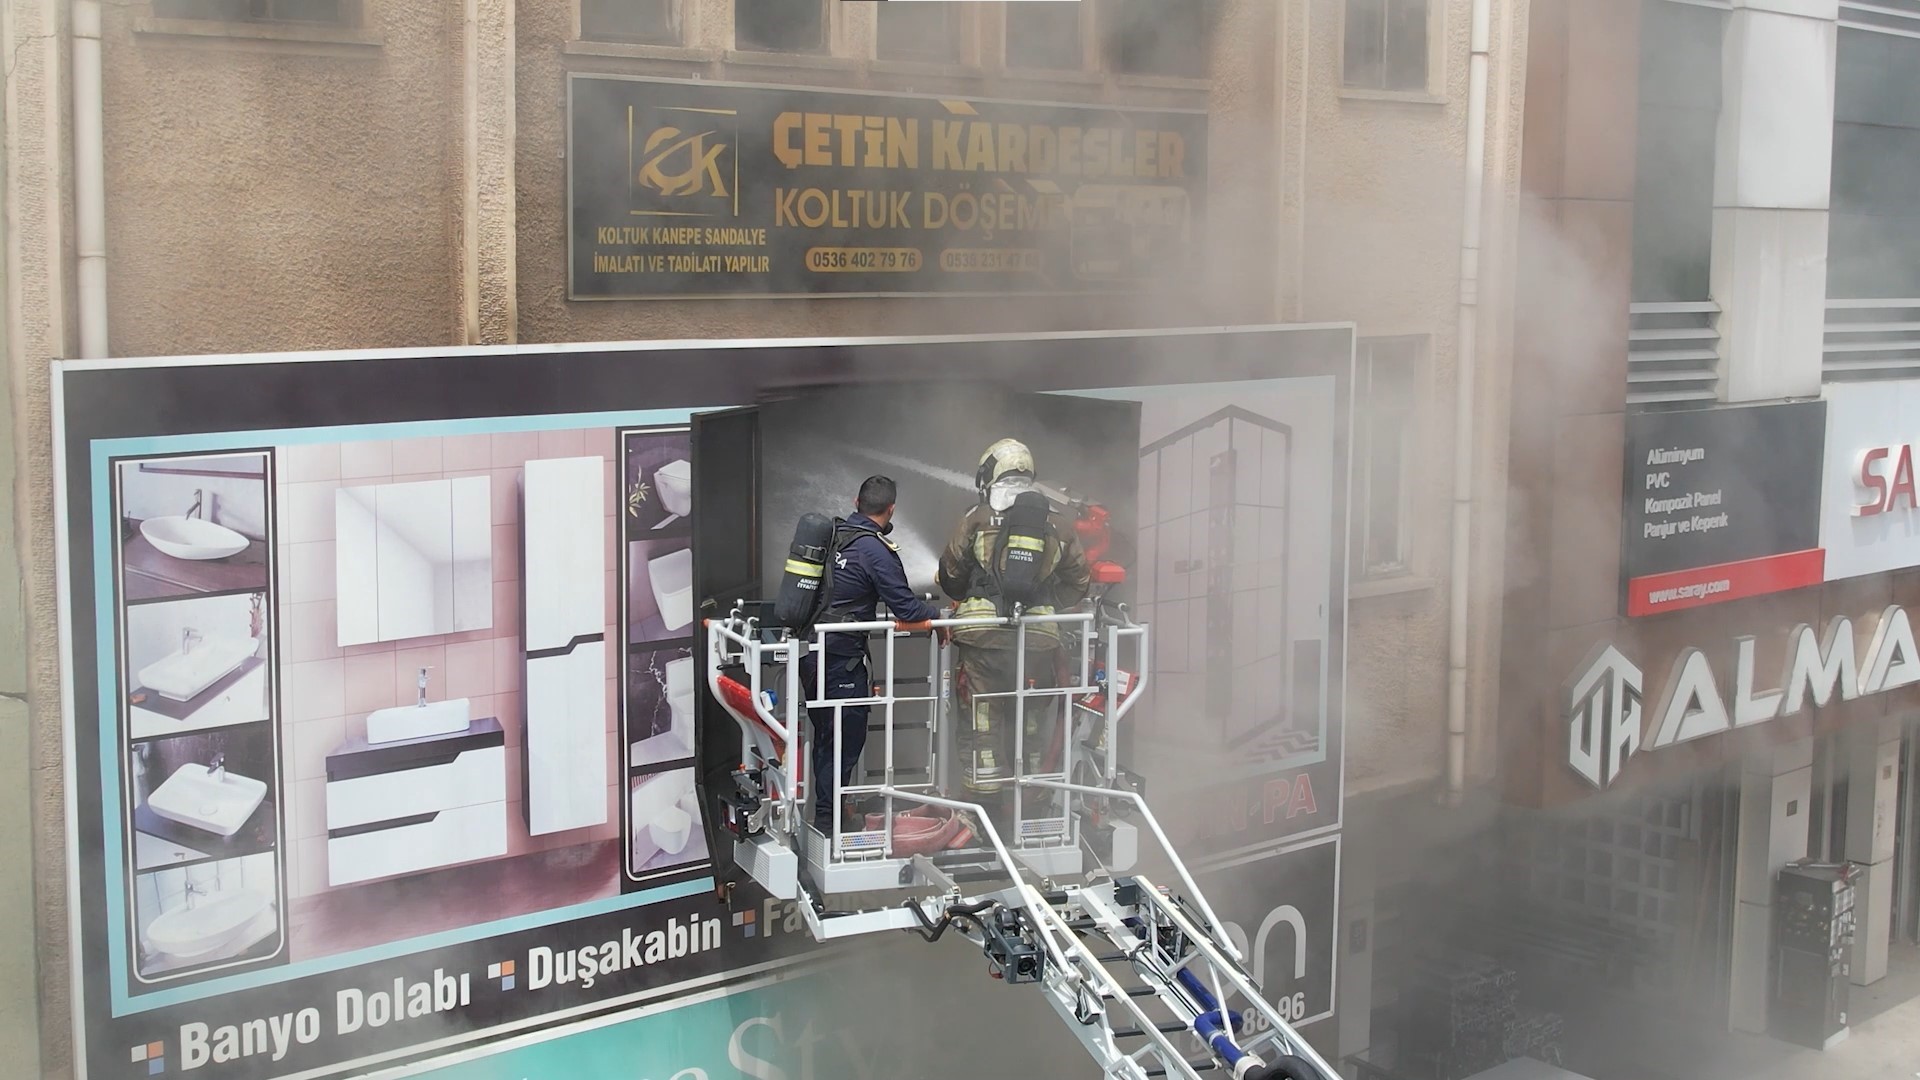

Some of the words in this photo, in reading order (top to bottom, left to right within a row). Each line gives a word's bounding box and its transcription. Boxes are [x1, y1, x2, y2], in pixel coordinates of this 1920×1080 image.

[773, 111, 918, 169] ÇETİN
[775, 188, 911, 229] KOLTUK
[598, 227, 649, 245] KOLTUK
[652, 228, 701, 245] KANEPE
[705, 228, 766, 246] SANDALYE
[594, 252, 644, 273] İMALATI
[648, 256, 664, 273] VE
[668, 252, 721, 273] TADİLATI
[725, 256, 769, 273] YAPILIR
[813, 252, 847, 268] 0536
[851, 252, 876, 268] 402
[880, 252, 896, 268] 79
[900, 252, 916, 268] 76
[1647, 447, 1704, 465] Alüminyum
[1646, 472, 1670, 489] PVC
[1645, 493, 1694, 514] Kompozit
[1694, 489, 1722, 508] Panel
[1643, 520, 1677, 539] Panjur
[1678, 520, 1690, 534] ve
[1691, 512, 1728, 533] Kepenk
[1649, 579, 1730, 604] www.saray.com
[180, 1006, 320, 1071] Banyo
[336, 968, 470, 1036] Dolabı
[528, 912, 721, 989] Duşakabin
